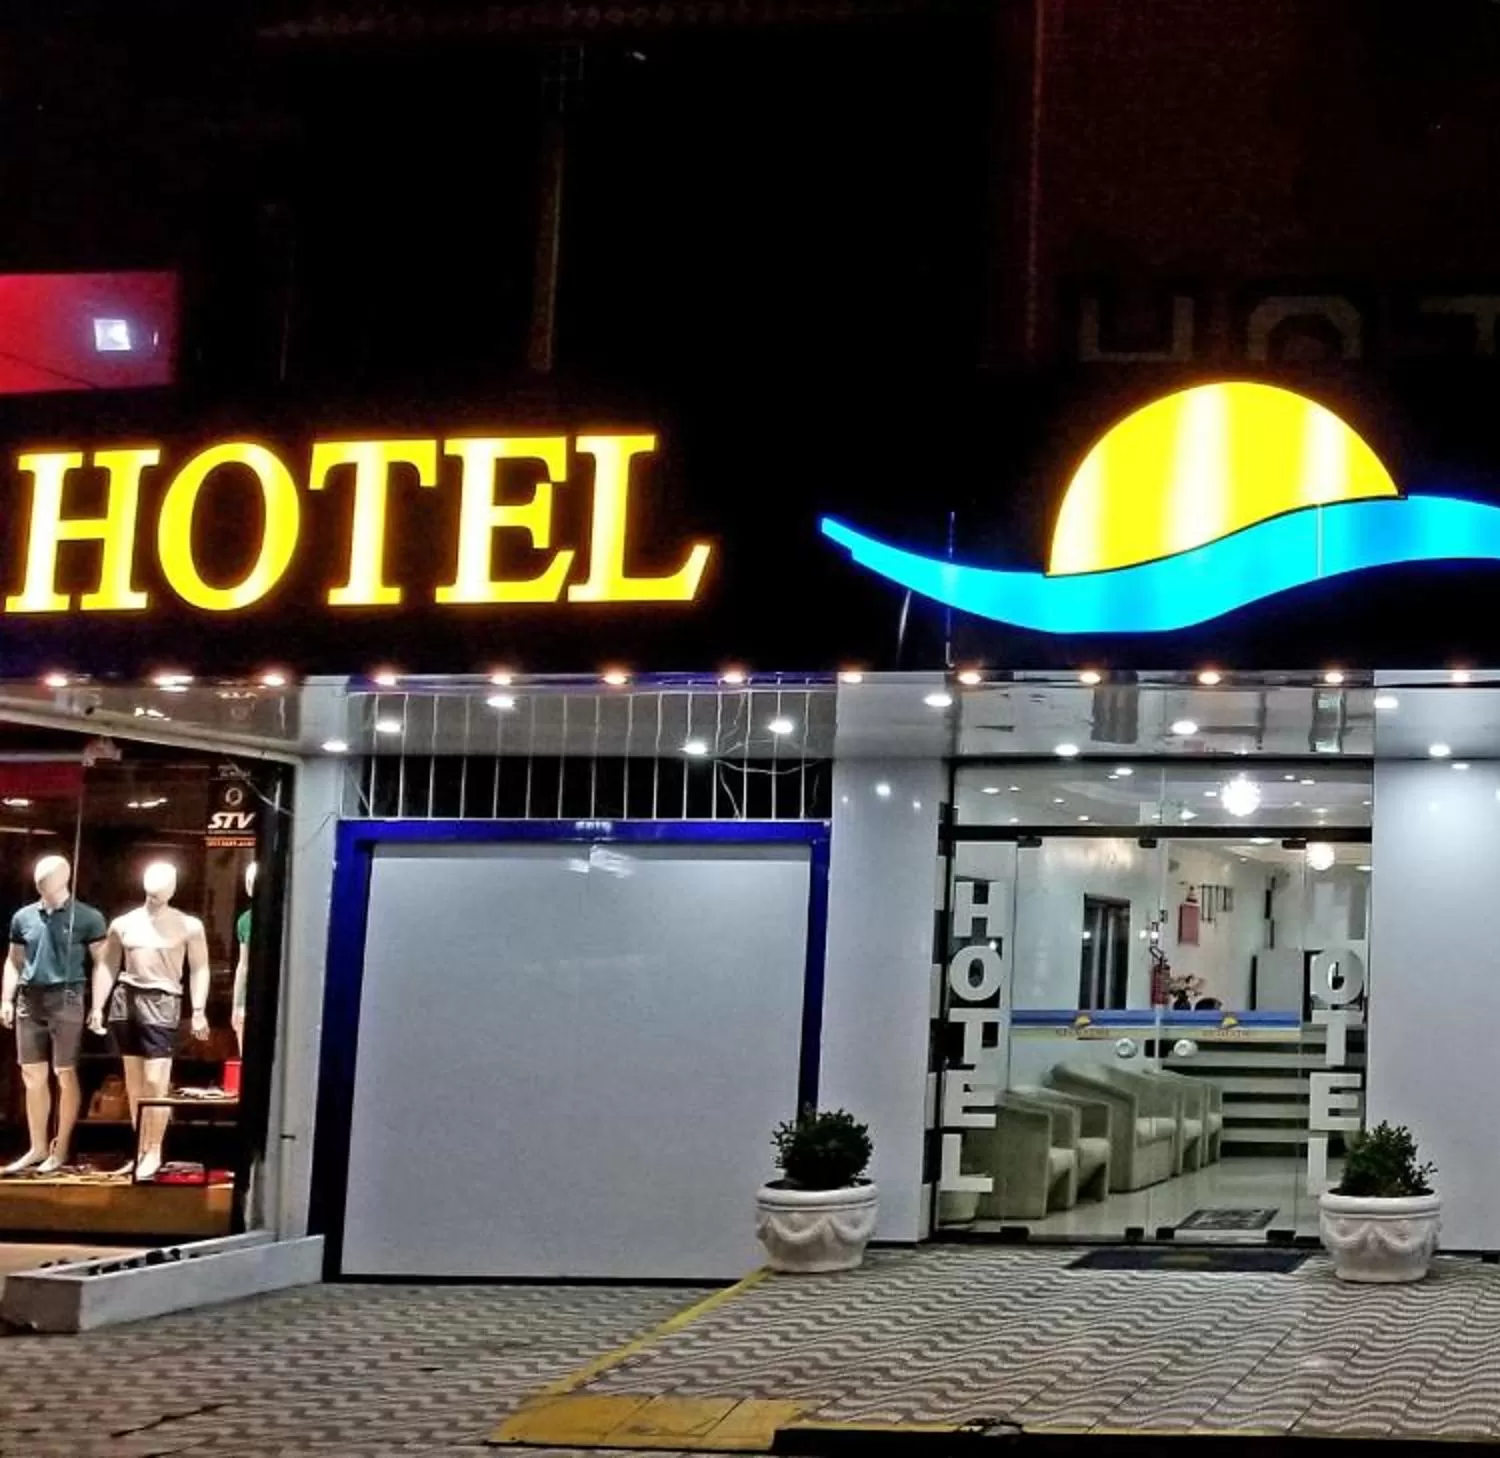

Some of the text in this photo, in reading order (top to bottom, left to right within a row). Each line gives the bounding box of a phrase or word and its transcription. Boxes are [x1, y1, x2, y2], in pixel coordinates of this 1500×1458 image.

[4, 433, 712, 614] HOTEL
[207, 812, 256, 829] STV
[940, 881, 1003, 1192] HOTEL
